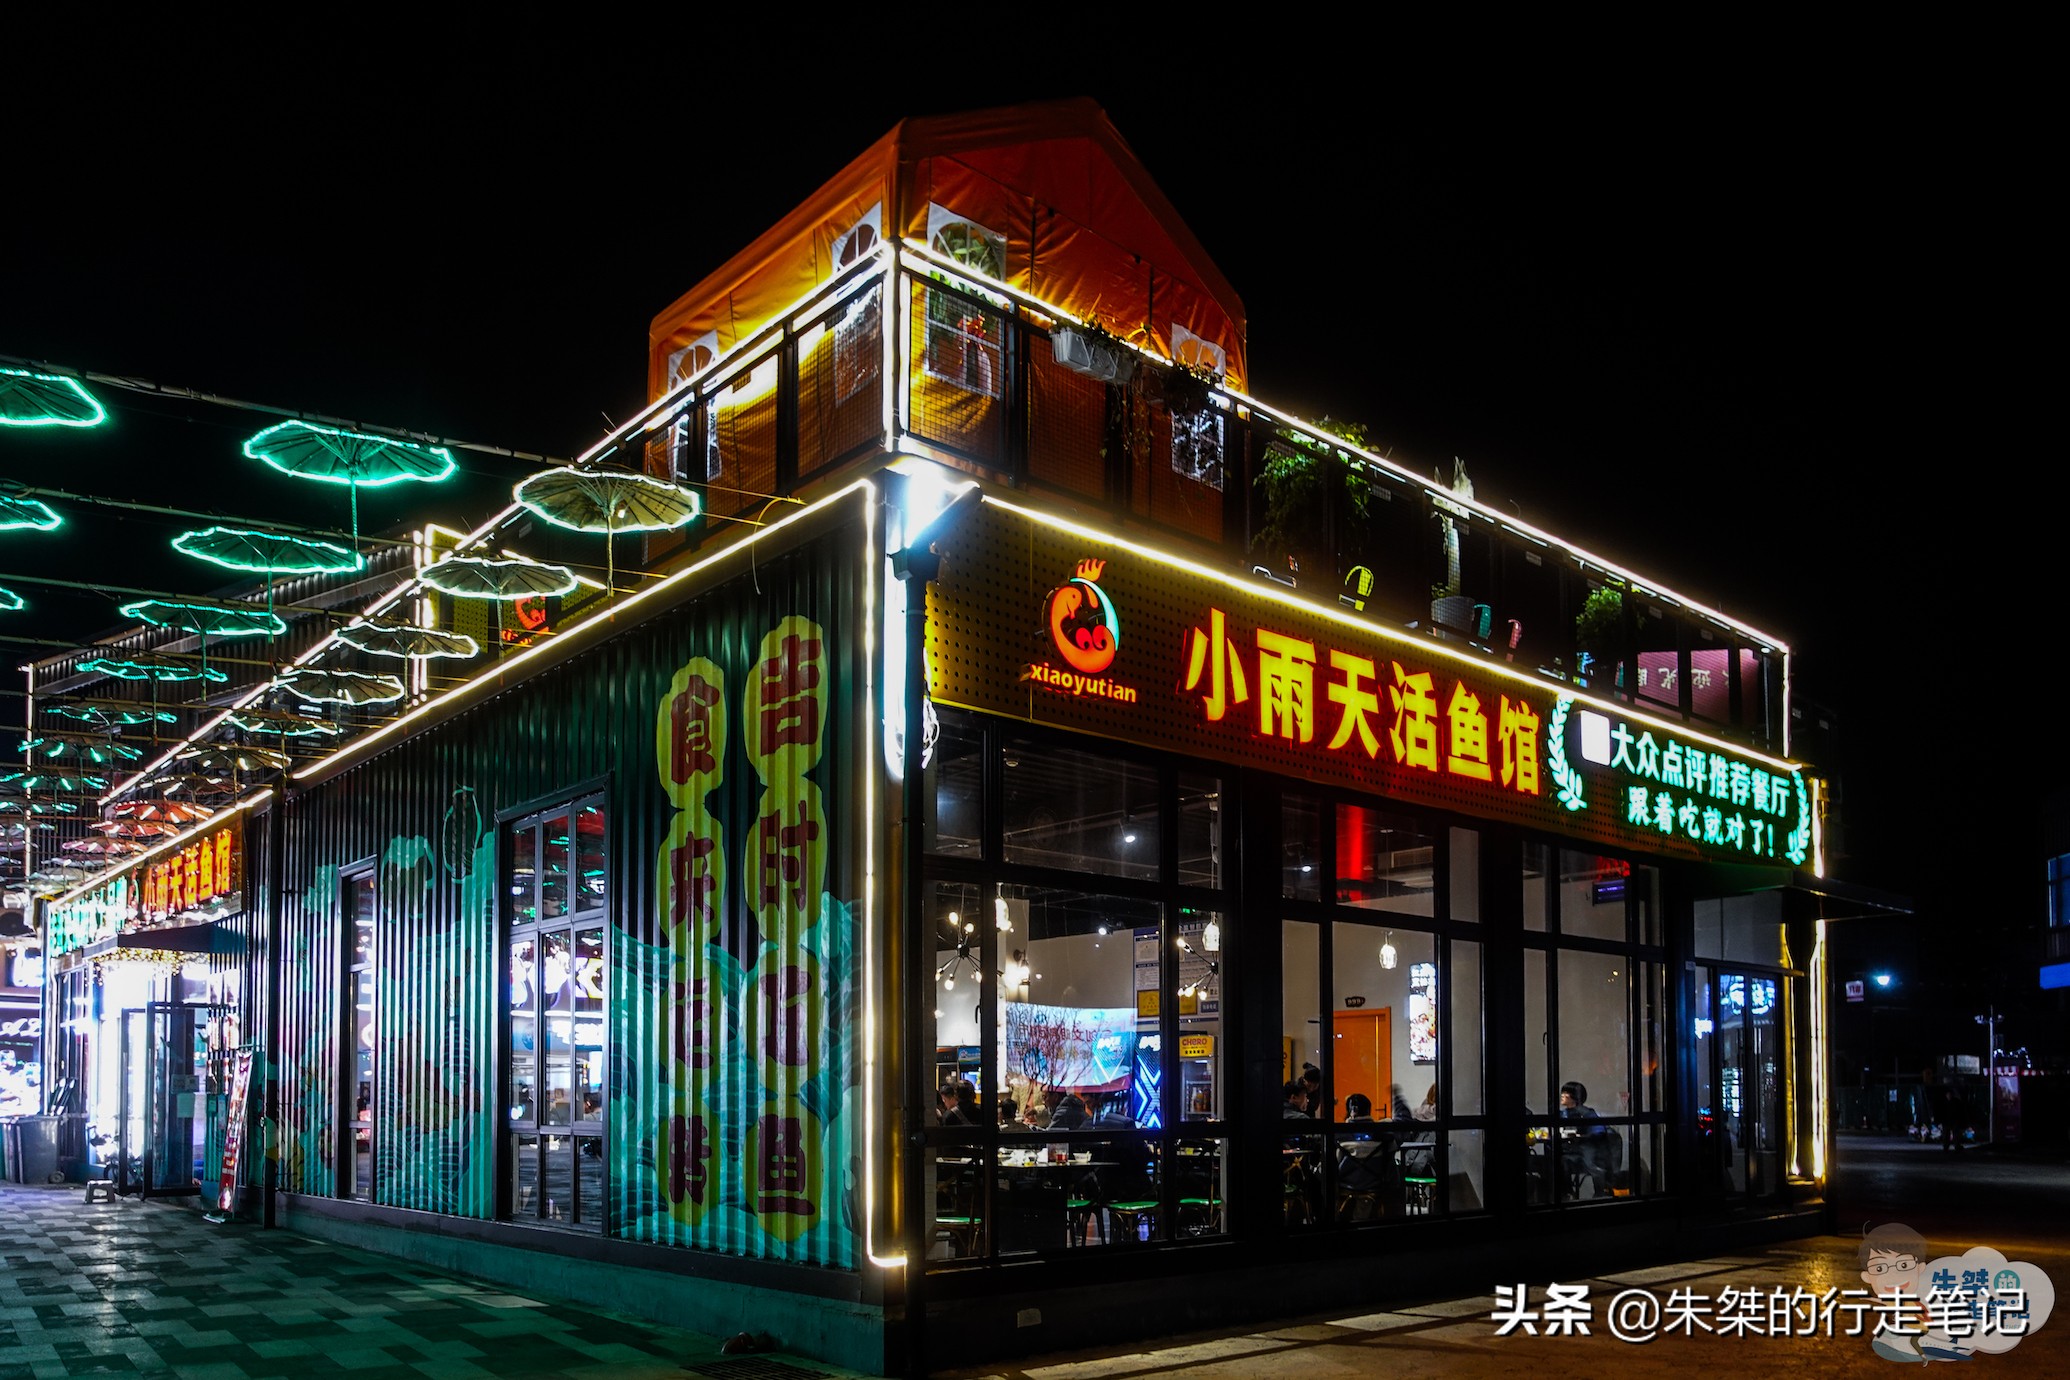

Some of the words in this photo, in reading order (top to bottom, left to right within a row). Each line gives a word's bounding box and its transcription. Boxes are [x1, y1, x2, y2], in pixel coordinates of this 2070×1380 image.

[1030, 662, 1137, 703] xiaoyutian
[1184, 606, 1540, 796] 小雨天活鱼馆
[1610, 722, 1791, 818] 大众点评推荐餐厅
[143, 828, 232, 918] 小雨天活鱼馆
